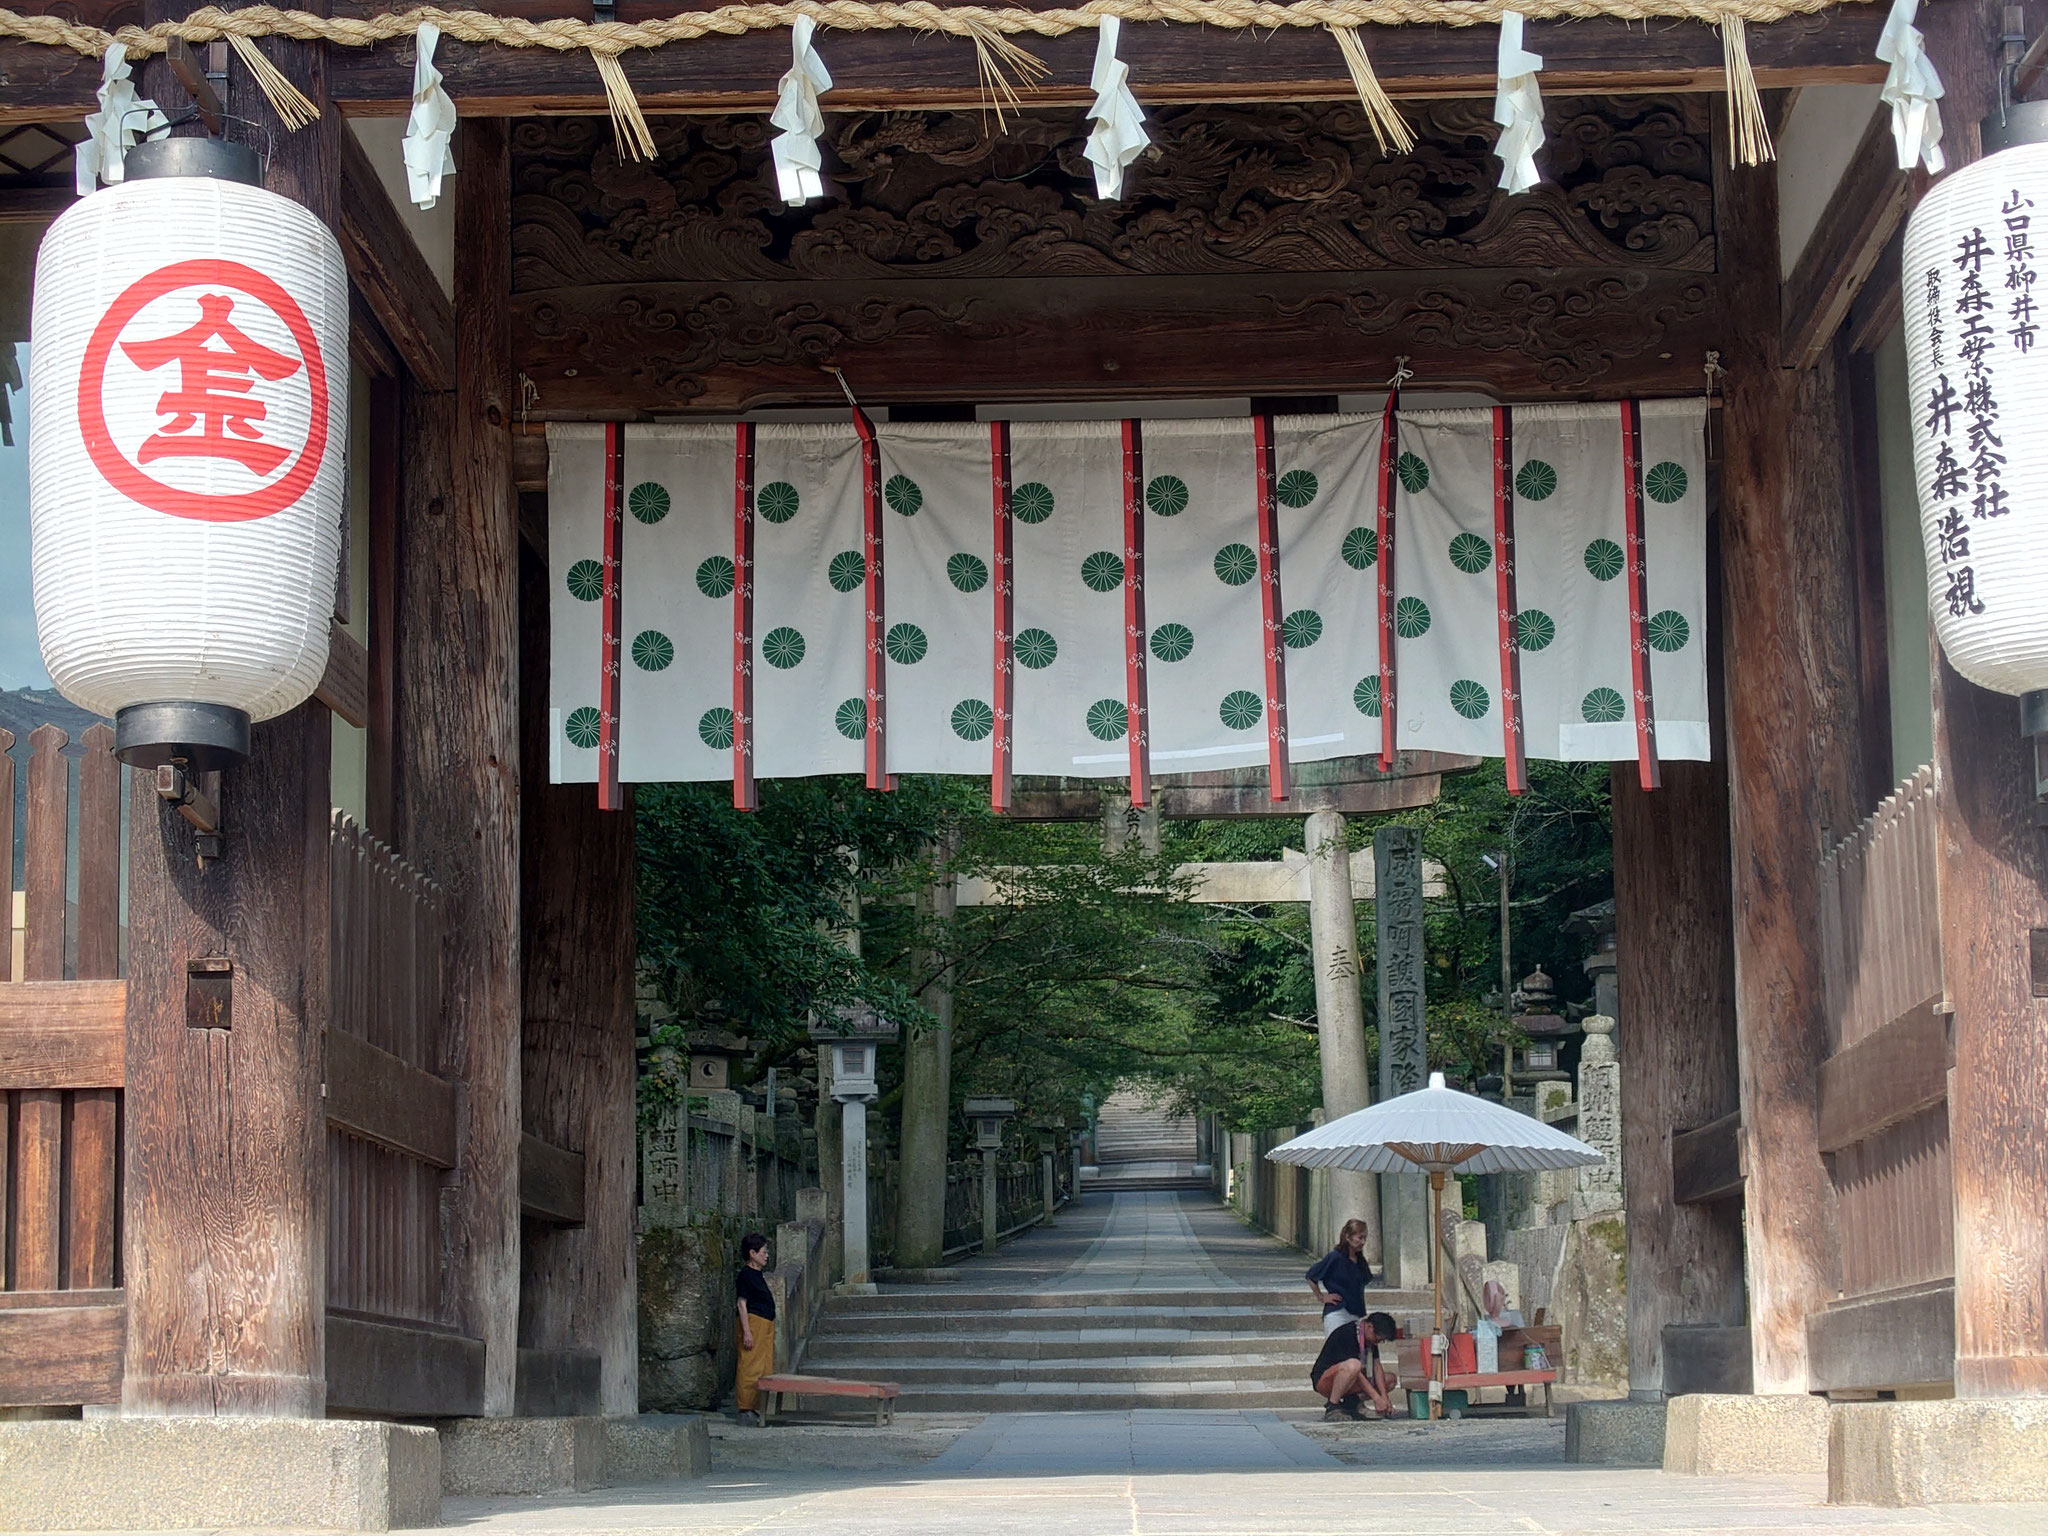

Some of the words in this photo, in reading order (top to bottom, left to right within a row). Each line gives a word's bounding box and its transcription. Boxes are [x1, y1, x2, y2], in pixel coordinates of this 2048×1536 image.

[1925, 267, 1945, 369] 取締役会長
[2001, 189, 2041, 354] 山口県柳井市
[119, 292, 302, 477] 金
[1952, 227, 2010, 520] 井森工業株式会社
[1326, 945, 1356, 984] 奉
